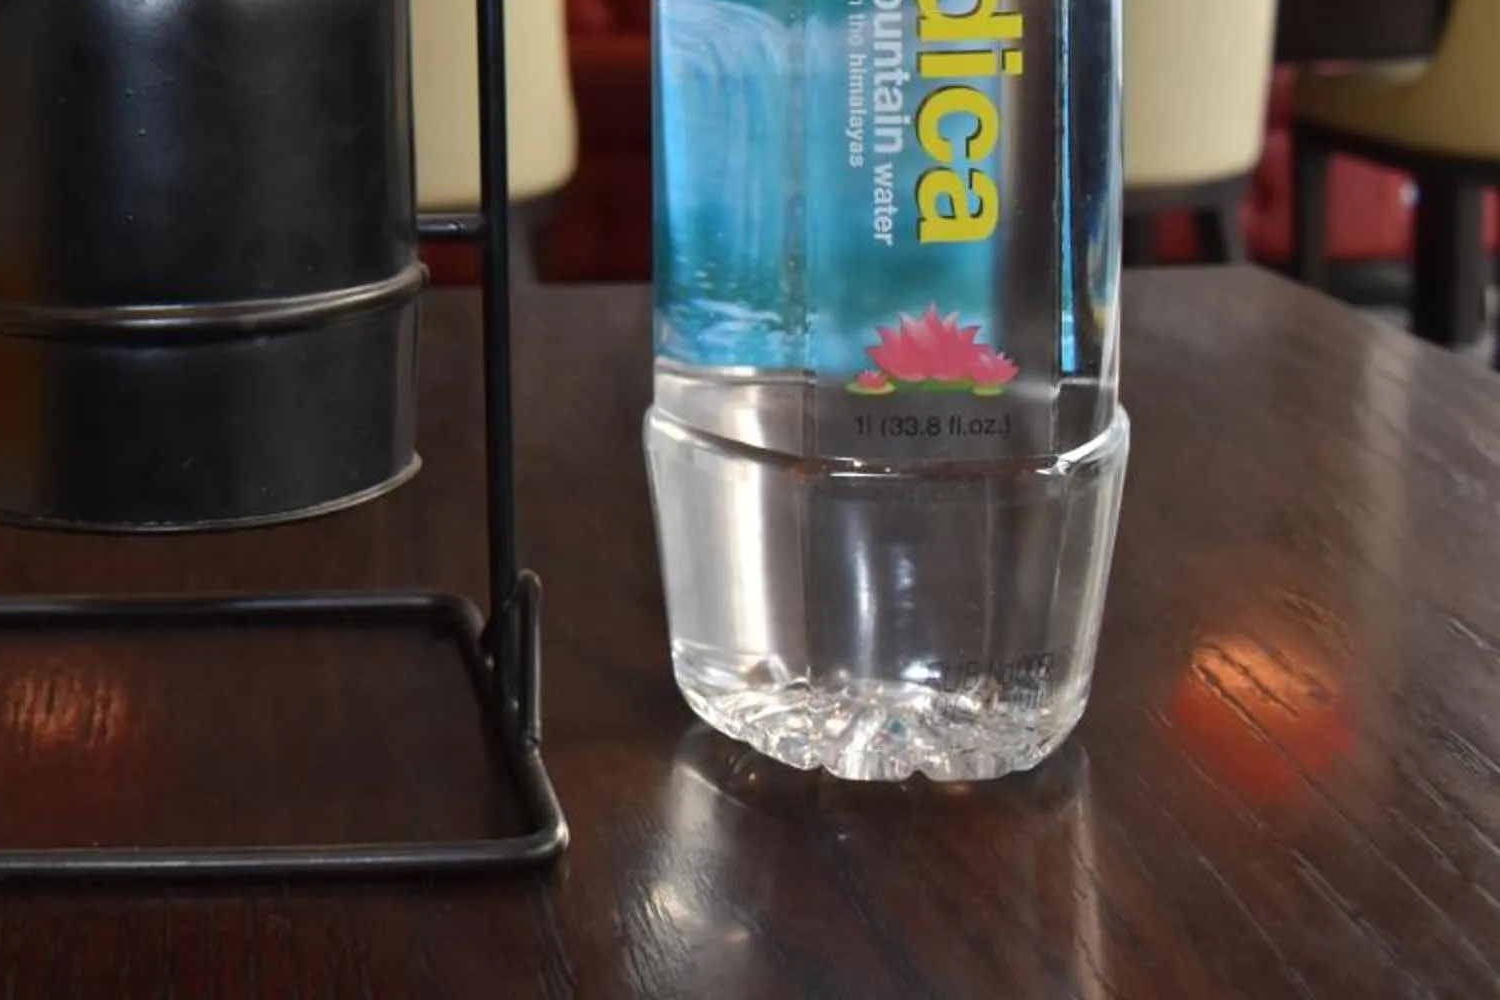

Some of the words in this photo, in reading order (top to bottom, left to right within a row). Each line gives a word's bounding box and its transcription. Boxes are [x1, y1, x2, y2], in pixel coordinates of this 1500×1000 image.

[847, 13, 866, 47] the
[845, 52, 868, 169] himalayas
[872, 161, 899, 247] water
[880, 414, 942, 438] (33.8
